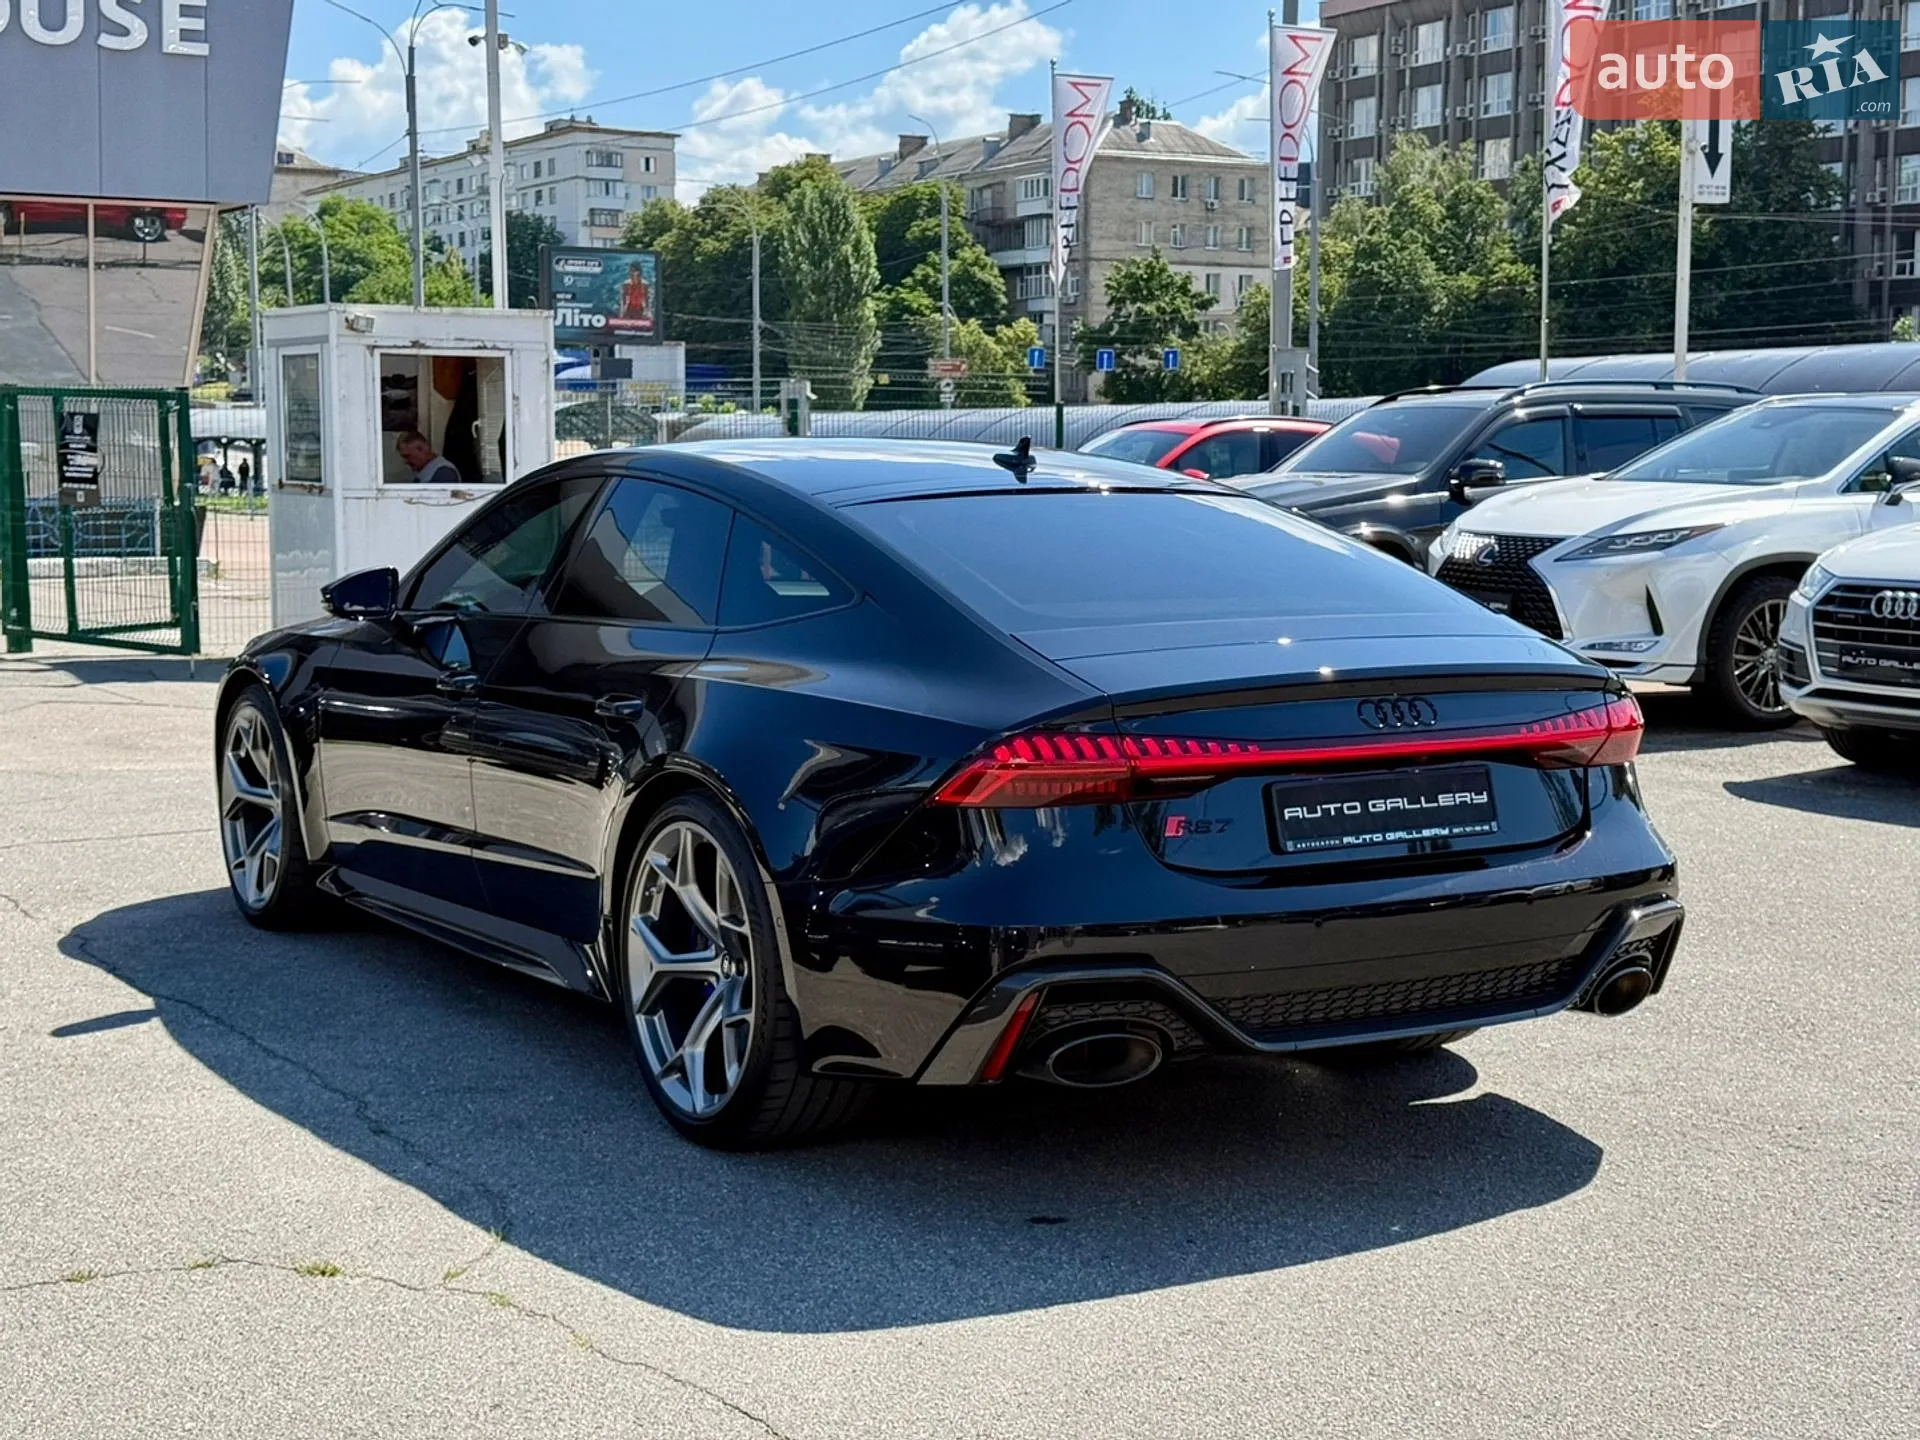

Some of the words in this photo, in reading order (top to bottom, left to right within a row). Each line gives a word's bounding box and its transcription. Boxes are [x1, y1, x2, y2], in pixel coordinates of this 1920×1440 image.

[0, 0, 210, 56] USE
[554, 308, 607, 328] Літо
[1841, 655, 1877, 665] AUTO
[1283, 801, 1362, 821] AUTO
[1368, 791, 1489, 812] GALLERY
[1342, 833, 1383, 845] AUTO
[1385, 827, 1450, 841] GALLERY
